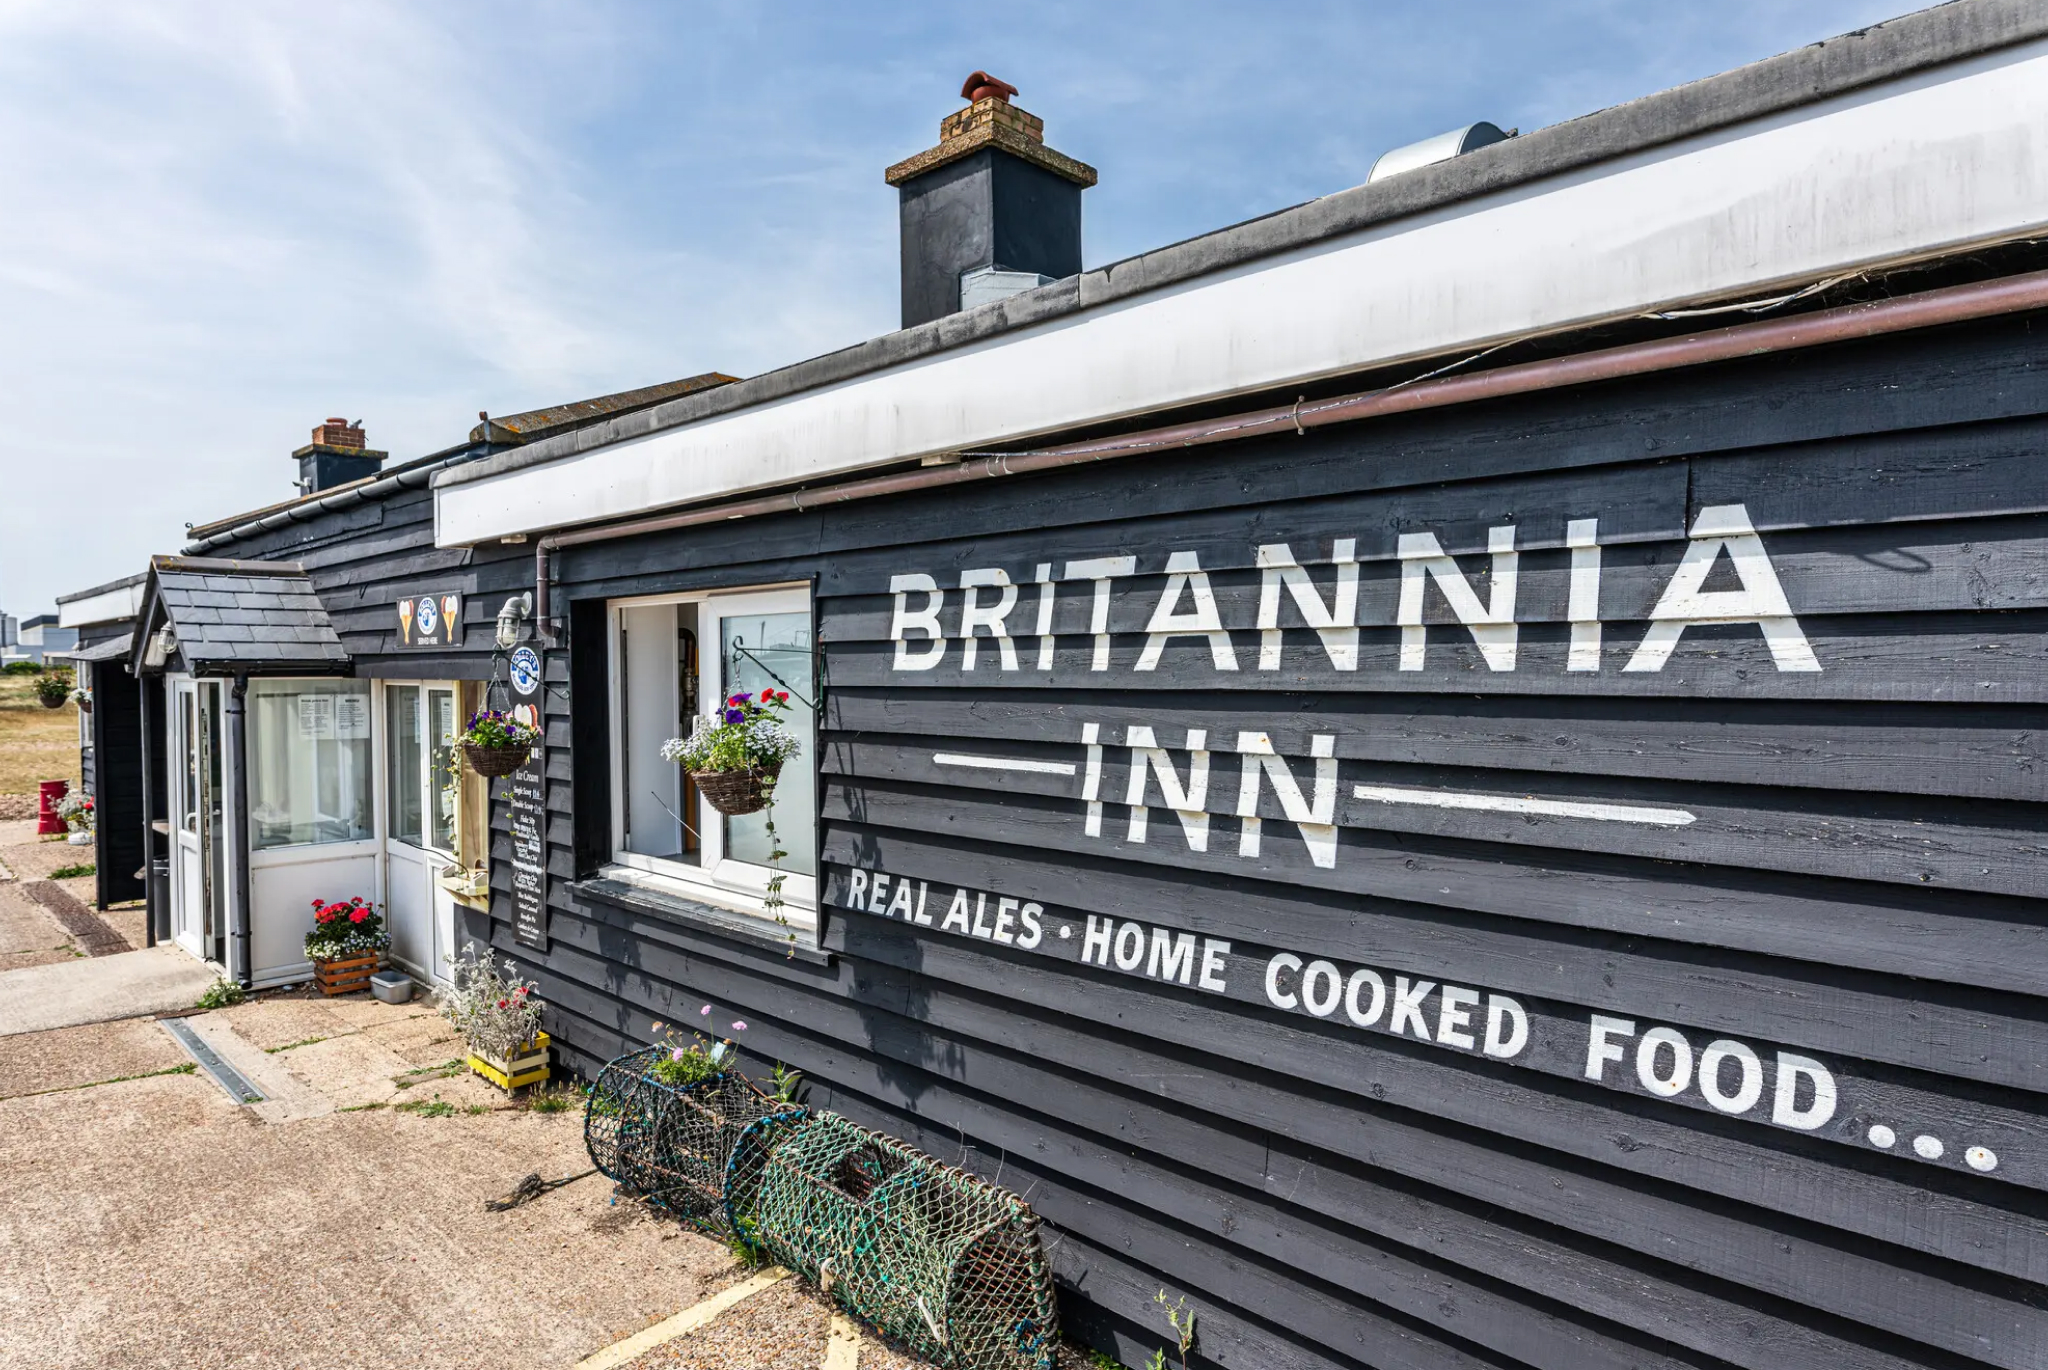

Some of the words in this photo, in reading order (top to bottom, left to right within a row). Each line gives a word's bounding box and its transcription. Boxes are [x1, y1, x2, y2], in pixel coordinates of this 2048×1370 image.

[889, 503, 1825, 673] BRITANNIA
[523, 770, 538, 783] Cream
[1081, 722, 1338, 870] INN
[846, 868, 933, 926] REAL
[940, 888, 1045, 950] ALES
[1081, 914, 1231, 993] HOME
[1265, 953, 1529, 1059] COOKED
